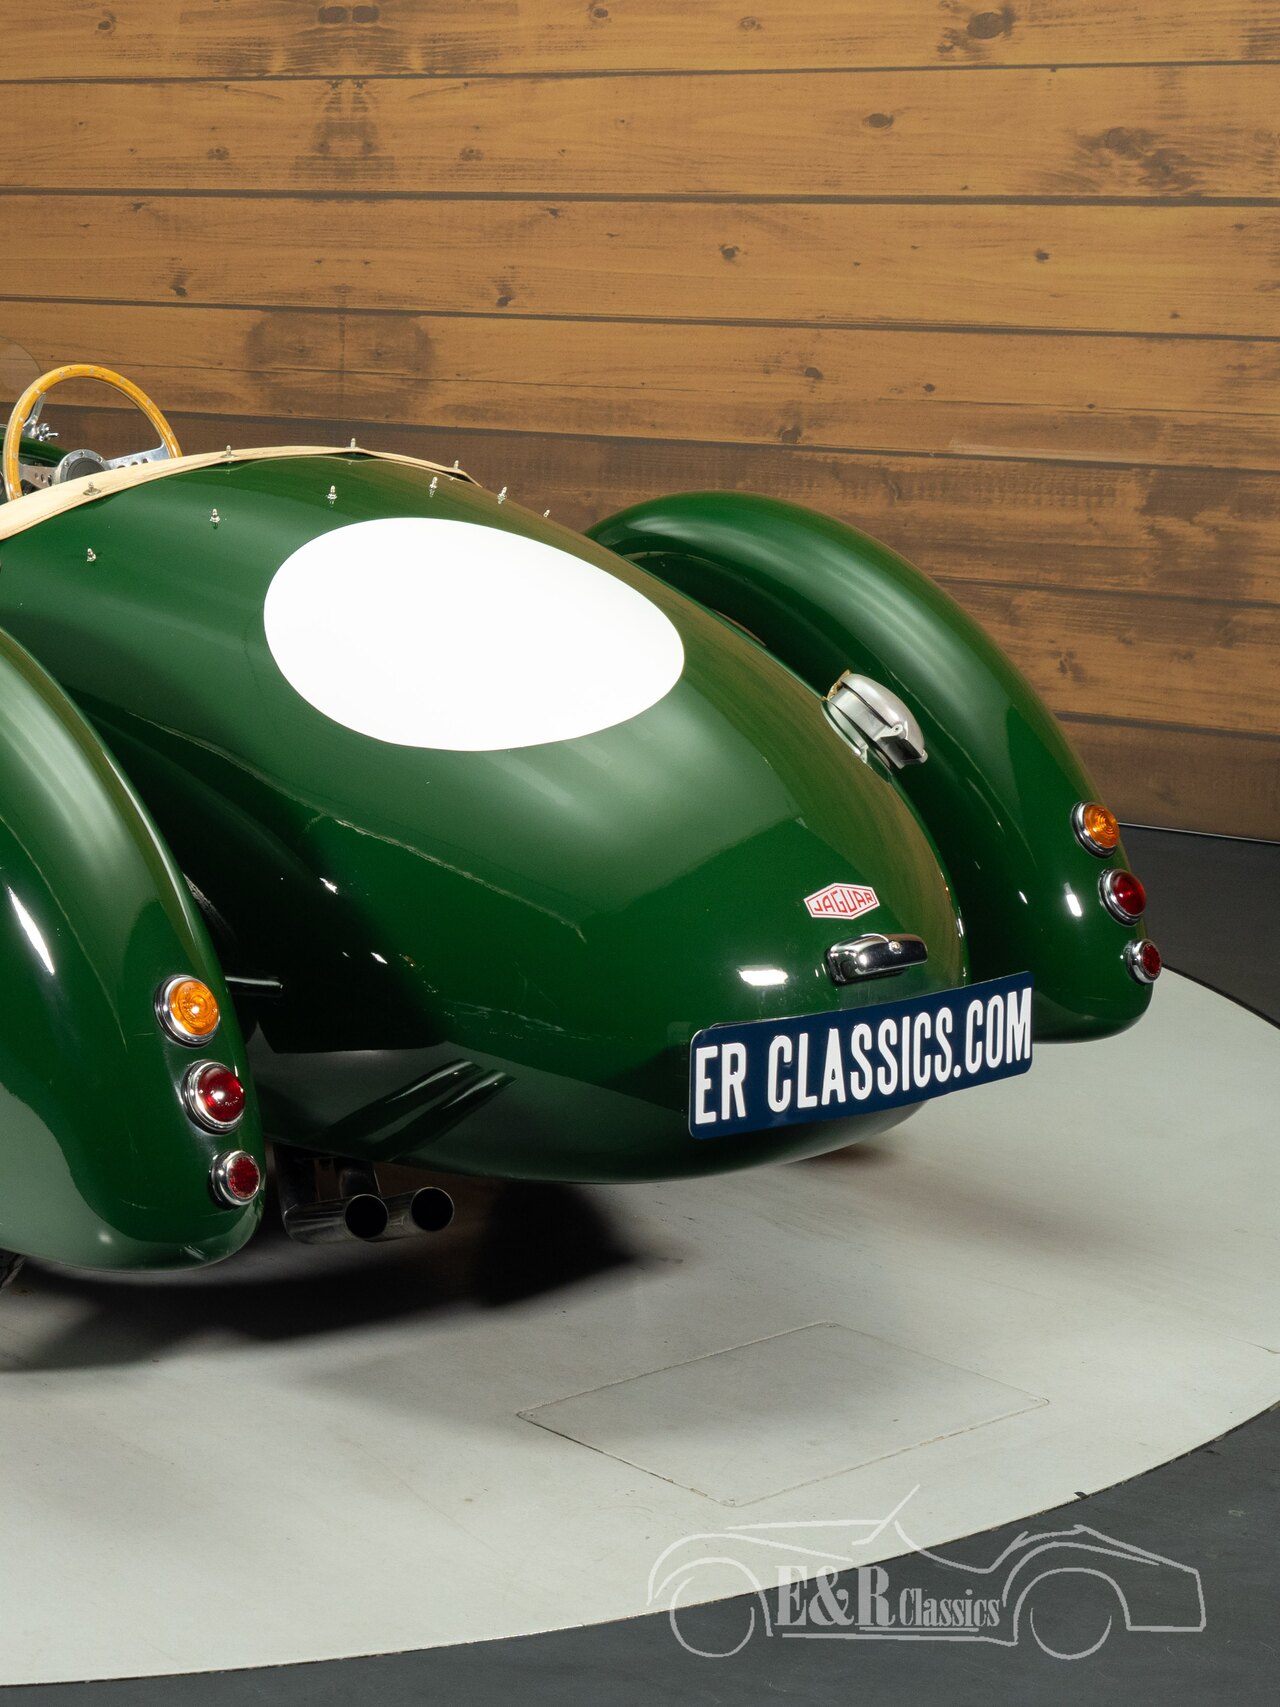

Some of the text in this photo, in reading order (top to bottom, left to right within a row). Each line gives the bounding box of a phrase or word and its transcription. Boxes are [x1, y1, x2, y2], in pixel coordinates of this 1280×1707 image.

[814, 889, 874, 913] JAGUAR
[695, 987, 1033, 1125] ER CLASSICS.COM
